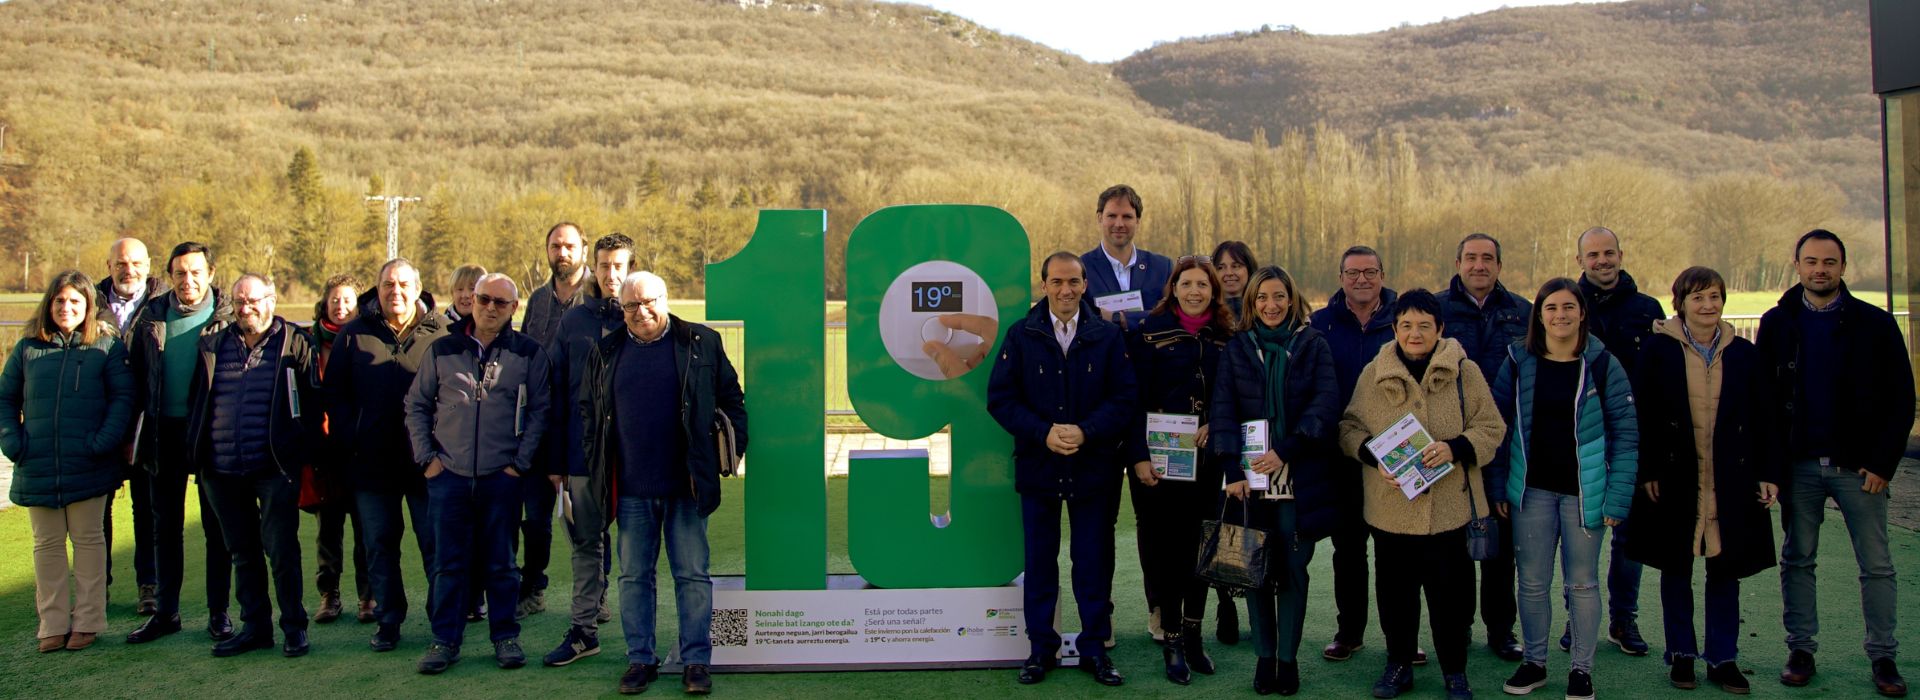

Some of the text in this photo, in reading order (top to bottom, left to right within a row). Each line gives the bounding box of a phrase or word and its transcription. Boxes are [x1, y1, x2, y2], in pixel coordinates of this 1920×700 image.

[705, 204, 1031, 589] 19
[755, 609, 805, 618] Nonahi dago
[864, 608, 943, 617] Está por todas partes
[755, 619, 784, 627] Seinale
[785, 619, 799, 627] bat
[800, 619, 826, 628] izango
[841, 618, 855, 626] da?
[864, 618, 885, 627] ¿Será
[902, 617, 926, 626] señal?
[825, 628, 858, 636] berogailua
[919, 626, 951, 634] calefacción
